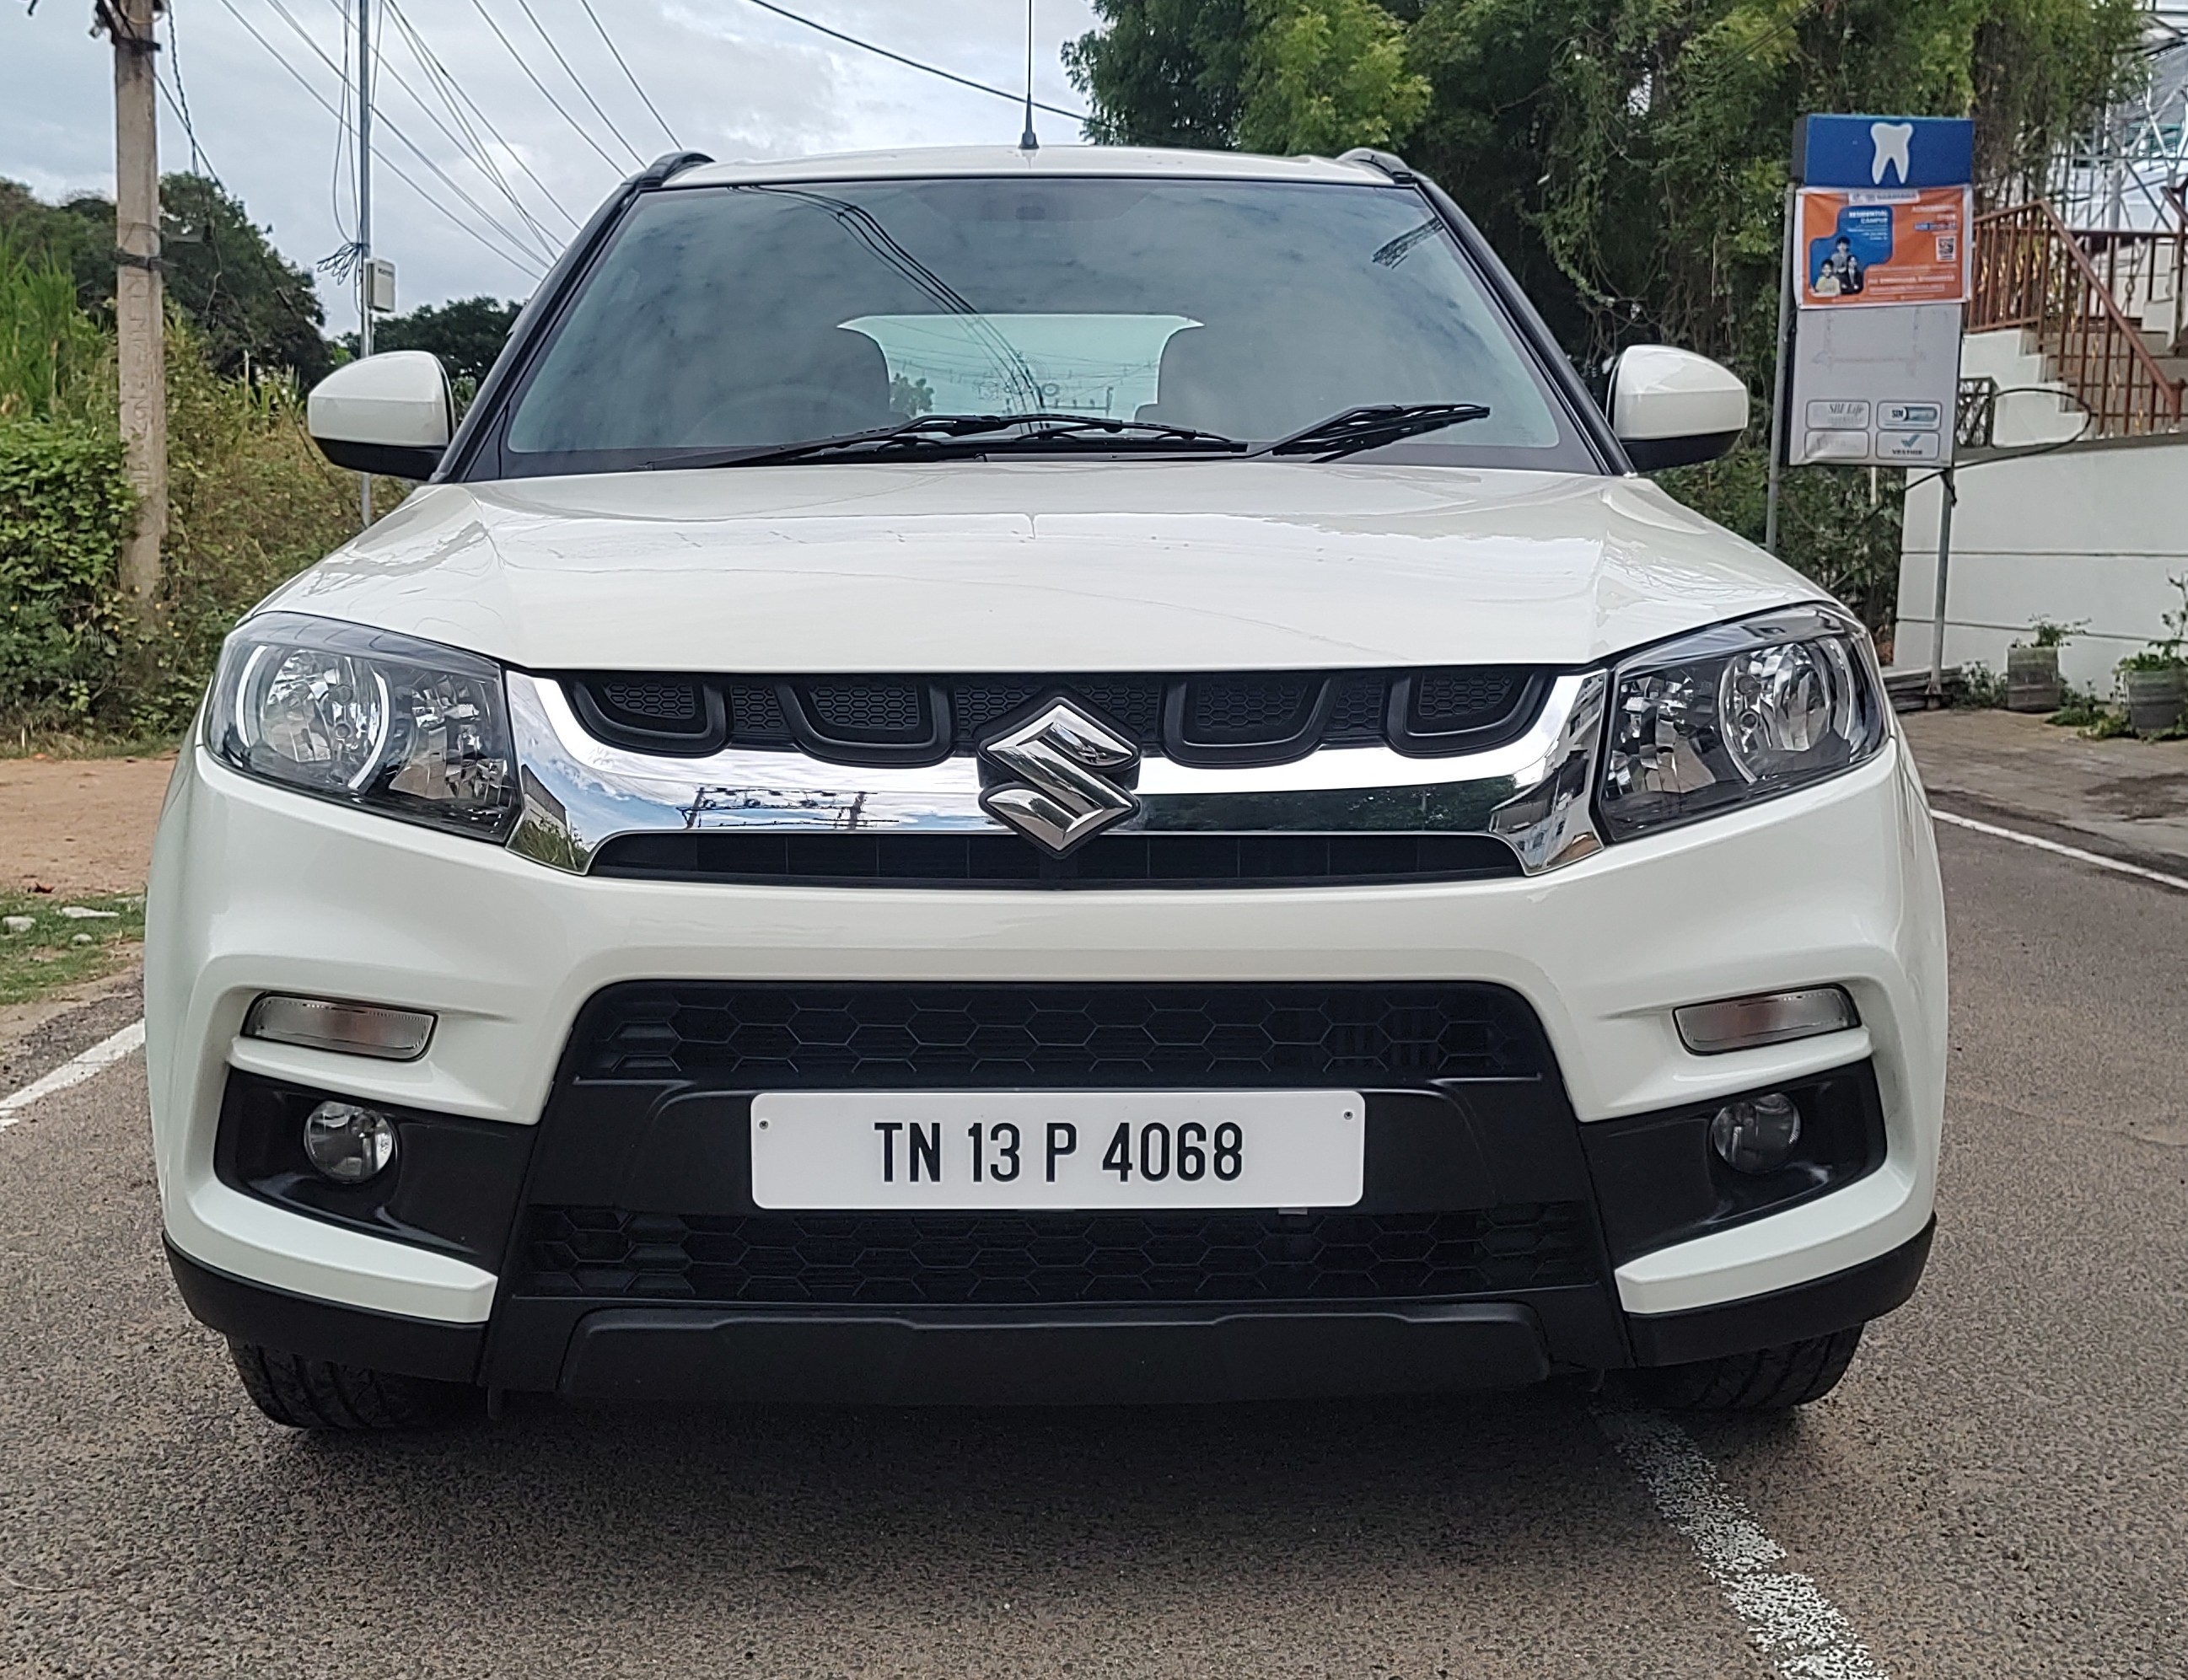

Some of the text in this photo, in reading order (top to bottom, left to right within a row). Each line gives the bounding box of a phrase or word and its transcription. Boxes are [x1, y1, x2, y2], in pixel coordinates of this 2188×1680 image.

[874, 1121, 1243, 1183] TN 13 P 4068
